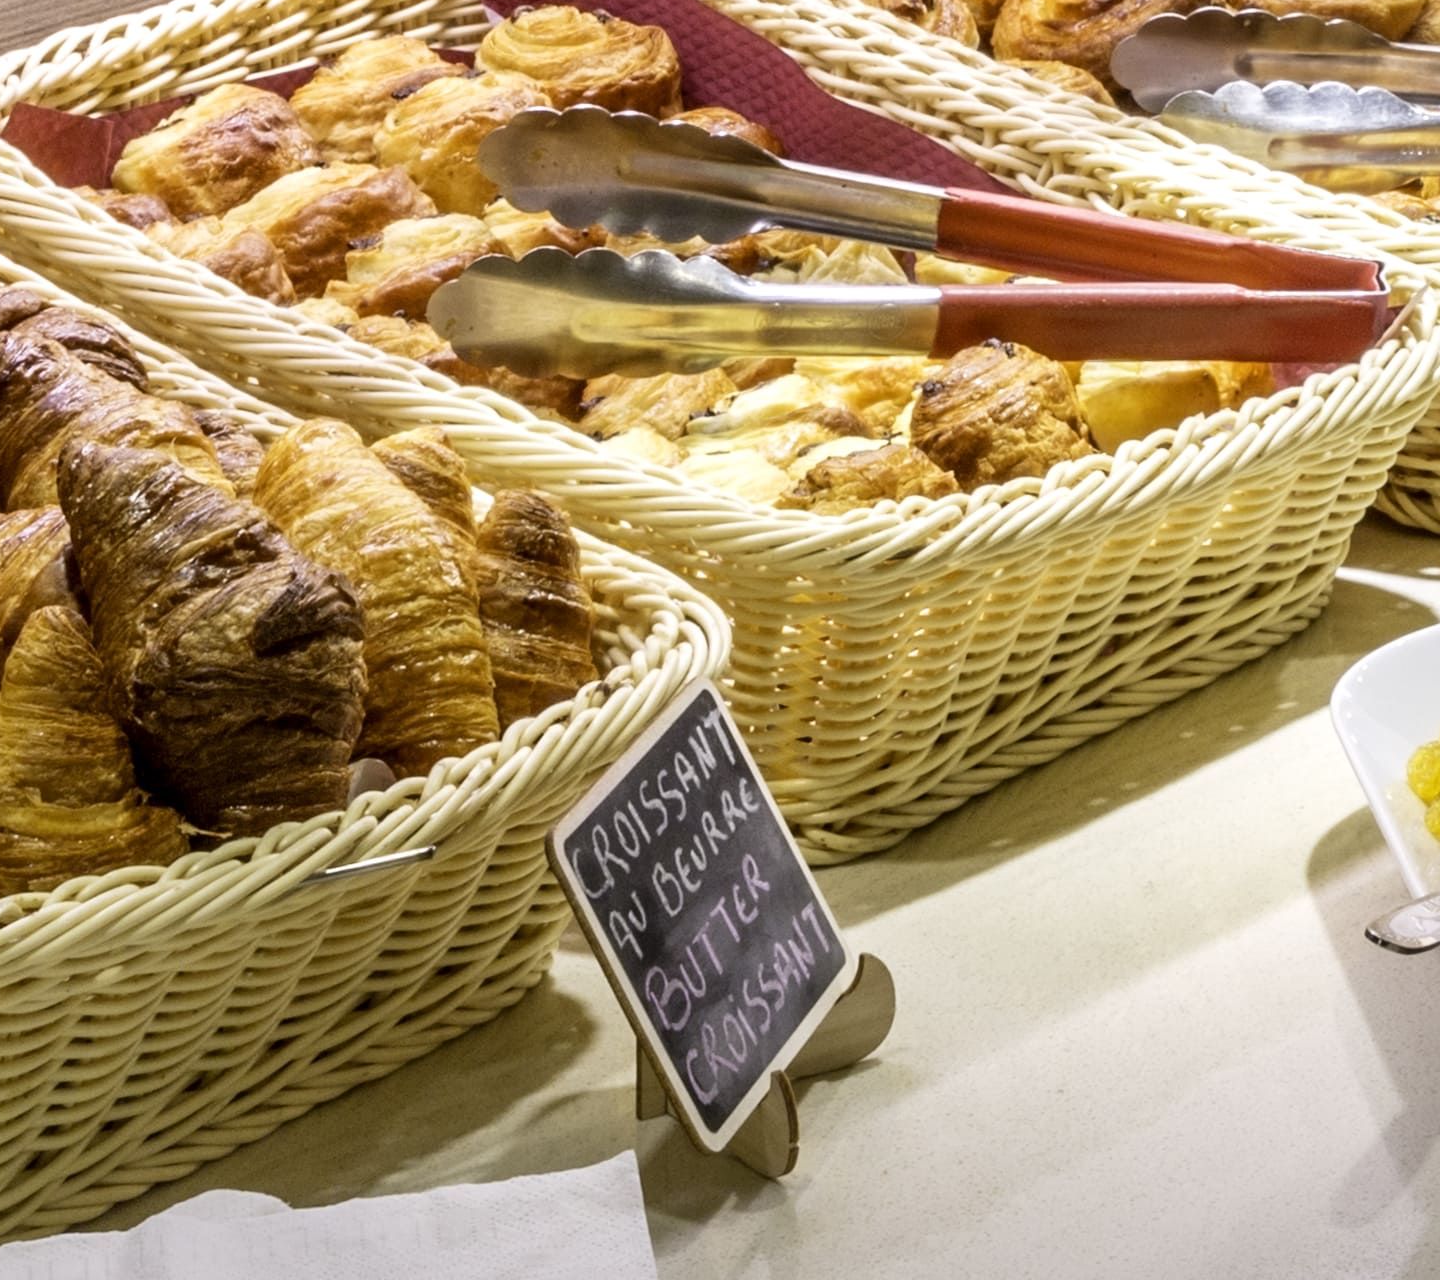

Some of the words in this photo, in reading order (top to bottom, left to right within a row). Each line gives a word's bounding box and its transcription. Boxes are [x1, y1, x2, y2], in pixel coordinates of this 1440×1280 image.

[571, 708, 737, 900] CROISSANT
[608, 892, 648, 960] AU
[651, 776, 761, 918] BEURRE
[644, 853, 771, 1032] BUTTER
